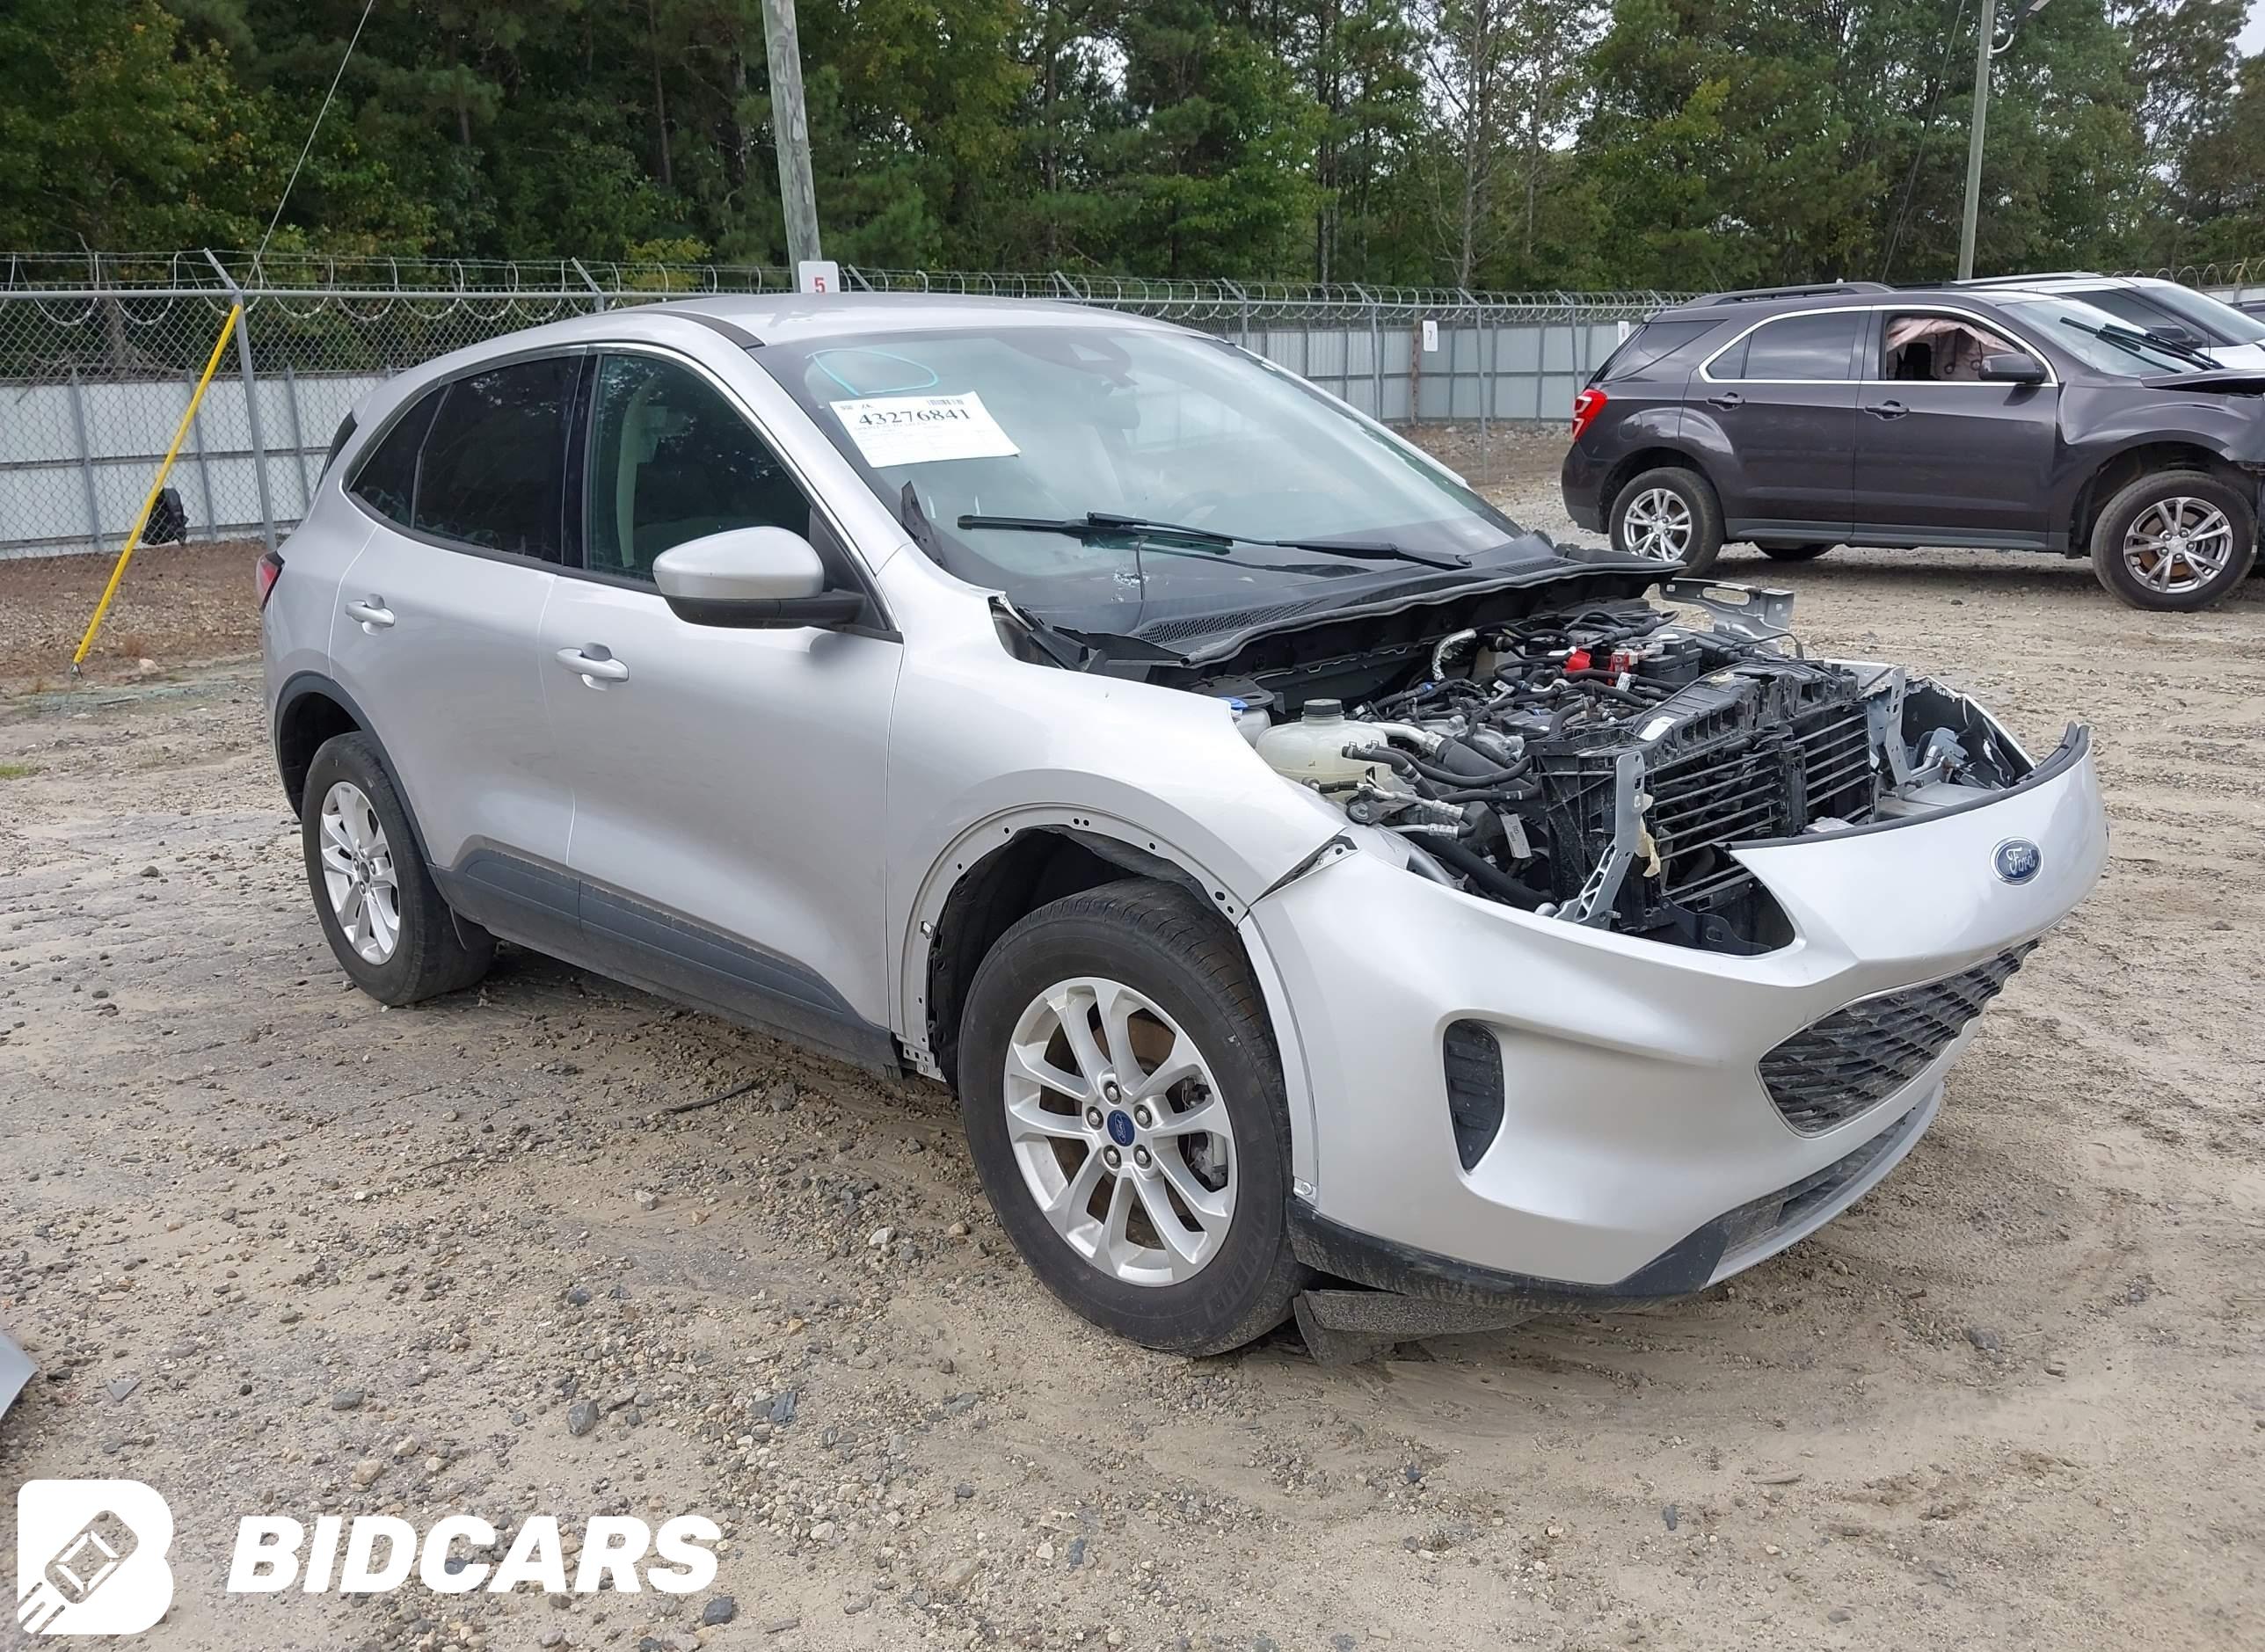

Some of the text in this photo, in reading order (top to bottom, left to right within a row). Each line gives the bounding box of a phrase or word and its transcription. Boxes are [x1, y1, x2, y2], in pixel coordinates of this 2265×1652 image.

[814, 277, 826, 293] 5
[859, 408, 970, 426] 43276841
[2006, 847, 2036, 876] Ford
